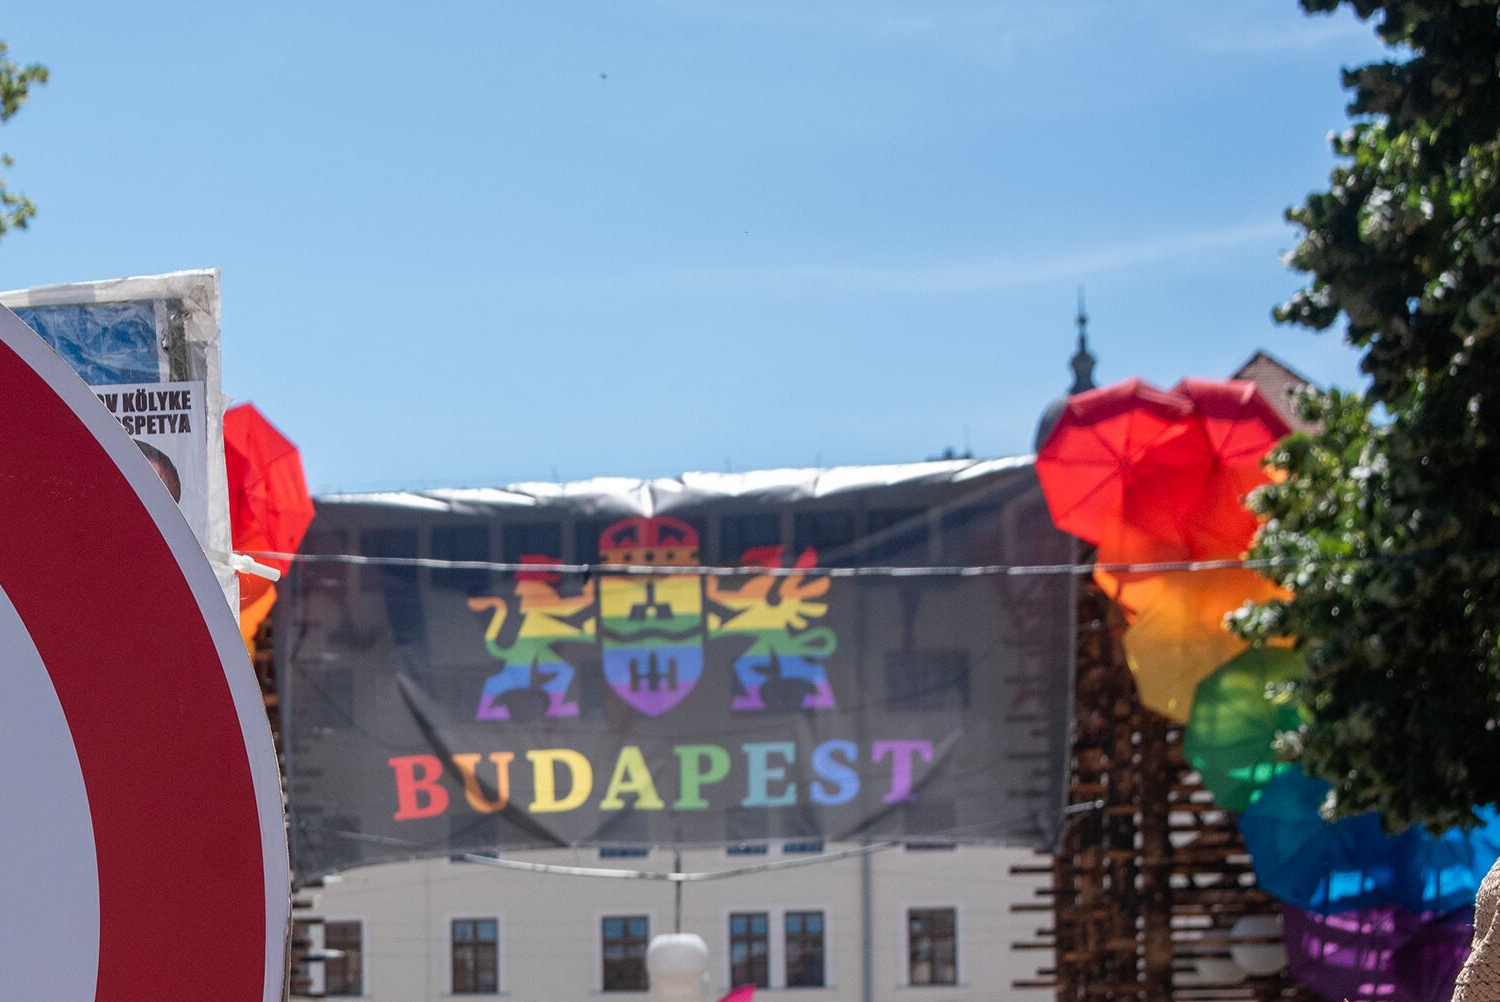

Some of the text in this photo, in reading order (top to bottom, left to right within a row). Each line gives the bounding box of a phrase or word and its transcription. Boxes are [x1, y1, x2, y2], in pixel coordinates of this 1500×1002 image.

[97, 389, 192, 414] V KÖLYKE
[116, 414, 192, 436] SPETYA
[389, 740, 933, 821] BUDAPEST
